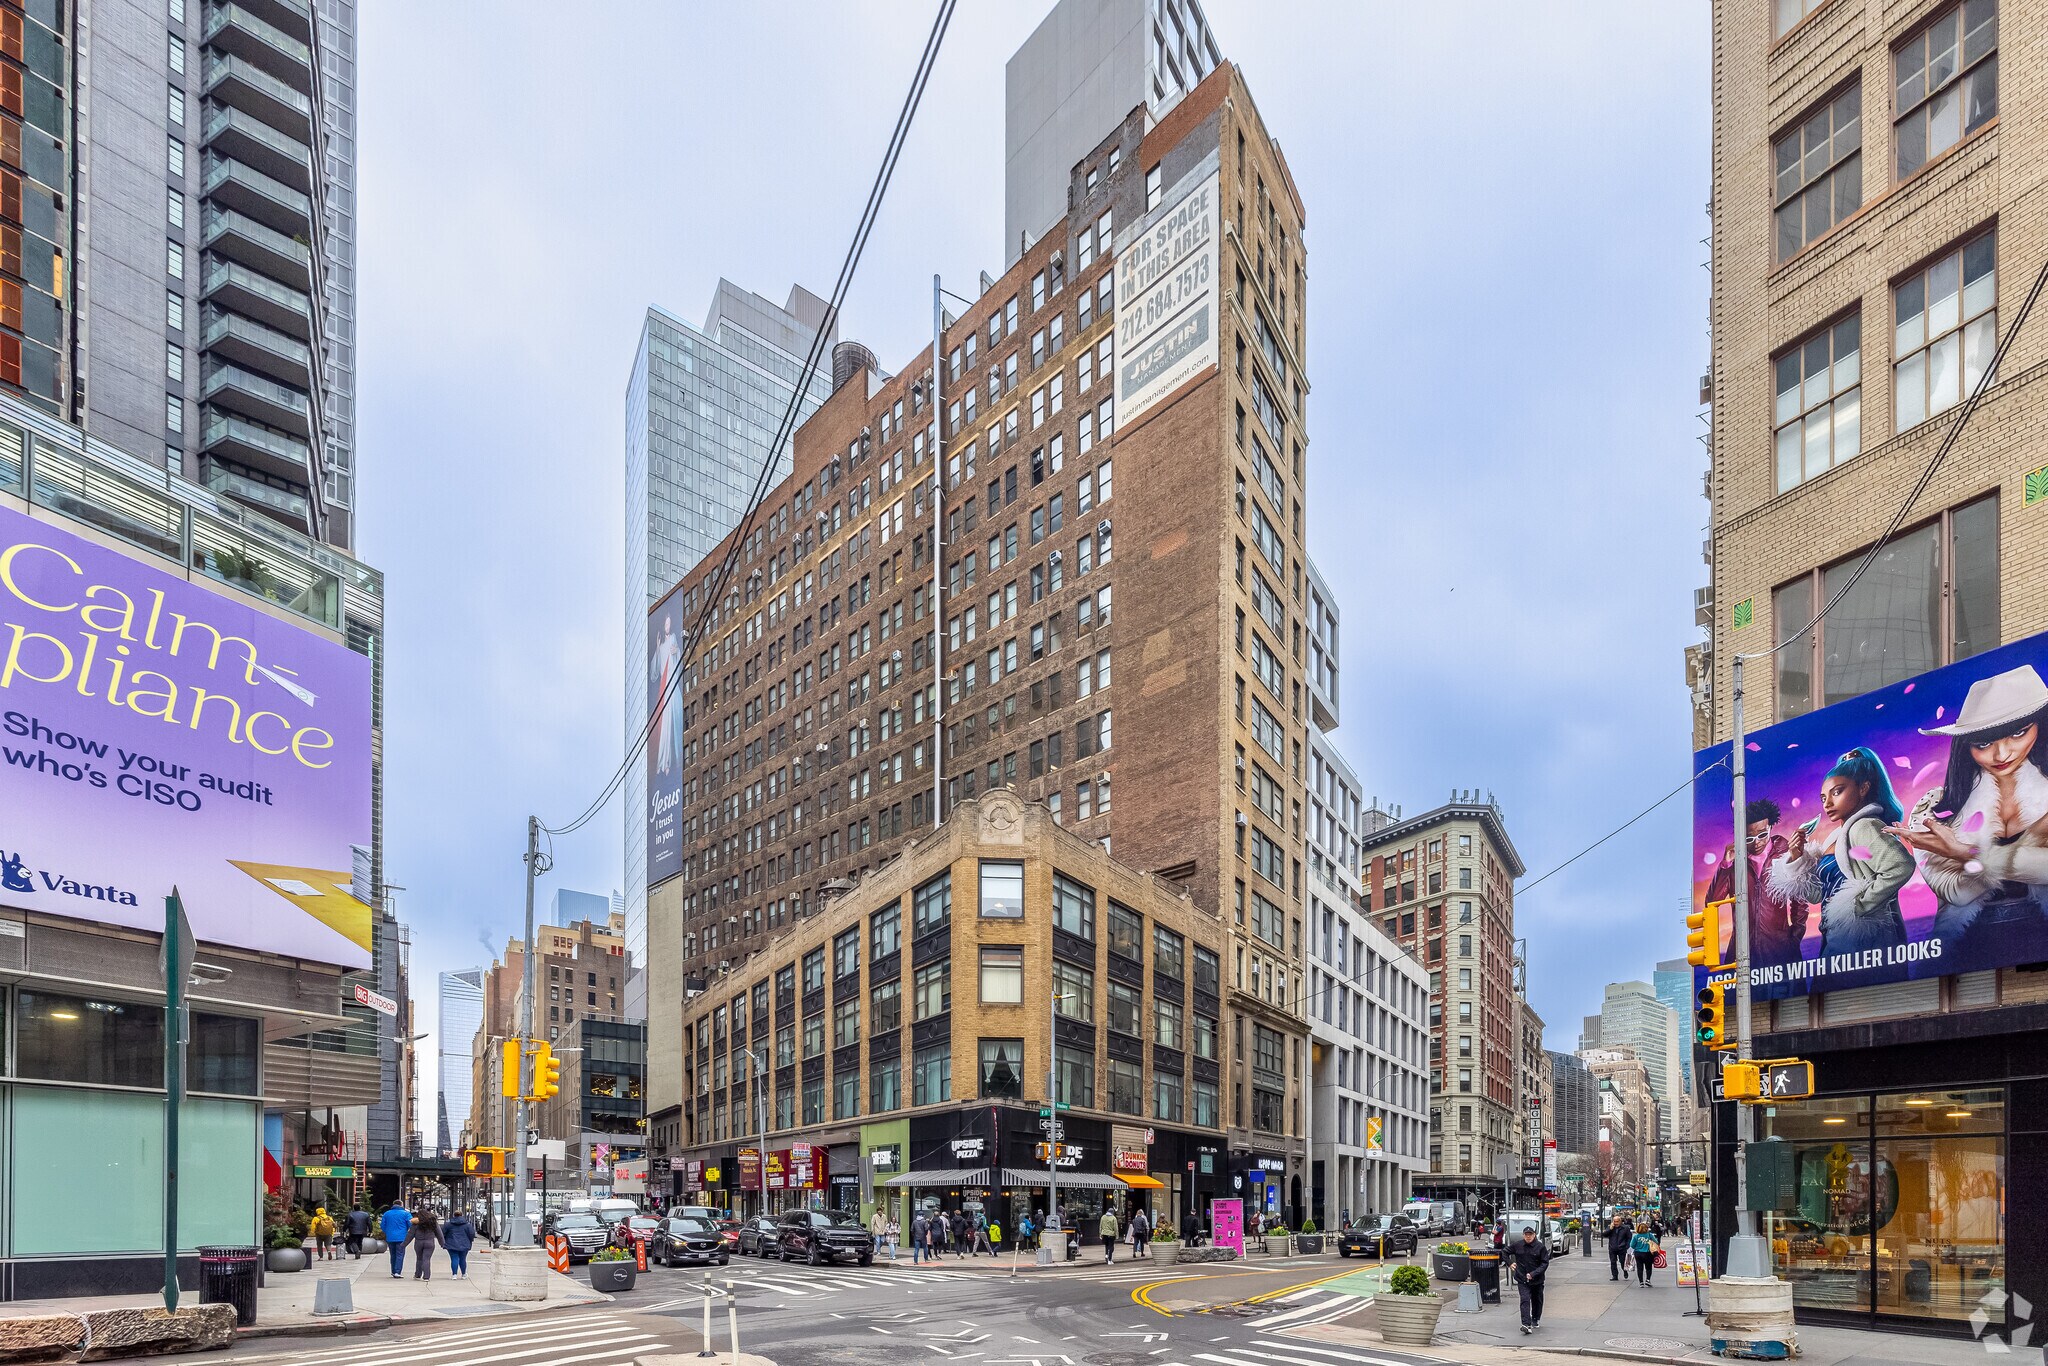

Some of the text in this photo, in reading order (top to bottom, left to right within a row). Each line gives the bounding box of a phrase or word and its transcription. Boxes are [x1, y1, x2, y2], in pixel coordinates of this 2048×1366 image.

[1121, 187, 1210, 279] FOR SPACE
[1121, 213, 1210, 304] IN THIS AREA
[1121, 252, 1210, 346] 212.684.7573
[1130, 318, 1199, 380] JUSTIN
[1136, 341, 1192, 384] MANAGEMENT
[1121, 354, 1210, 423] justinmanagement.com
[0, 622, 335, 769] pliance
[1, 745, 202, 812] who's CISO
[3, 710, 273, 806] Show your audit
[650, 788, 681, 823] Jesus
[655, 813, 674, 831] I trust
[655, 828, 674, 845] in you
[38, 870, 139, 907] Vanta
[1786, 957, 1826, 981] WITH
[1830, 948, 1883, 974] KILLER
[1887, 938, 1943, 966] LOOKS
[356, 987, 396, 1012] BIG OUTDOOR
[951, 1138, 984, 1151] UPSIDE
[956, 1150, 979, 1159] PIZZA
[1531, 1110, 1539, 1156] GIFTS
[1125, 1160, 1146, 1169] DONUTS
[1258, 1159, 1270, 1170] KPOP
[962, 1188, 984, 1198] UPSIDE
